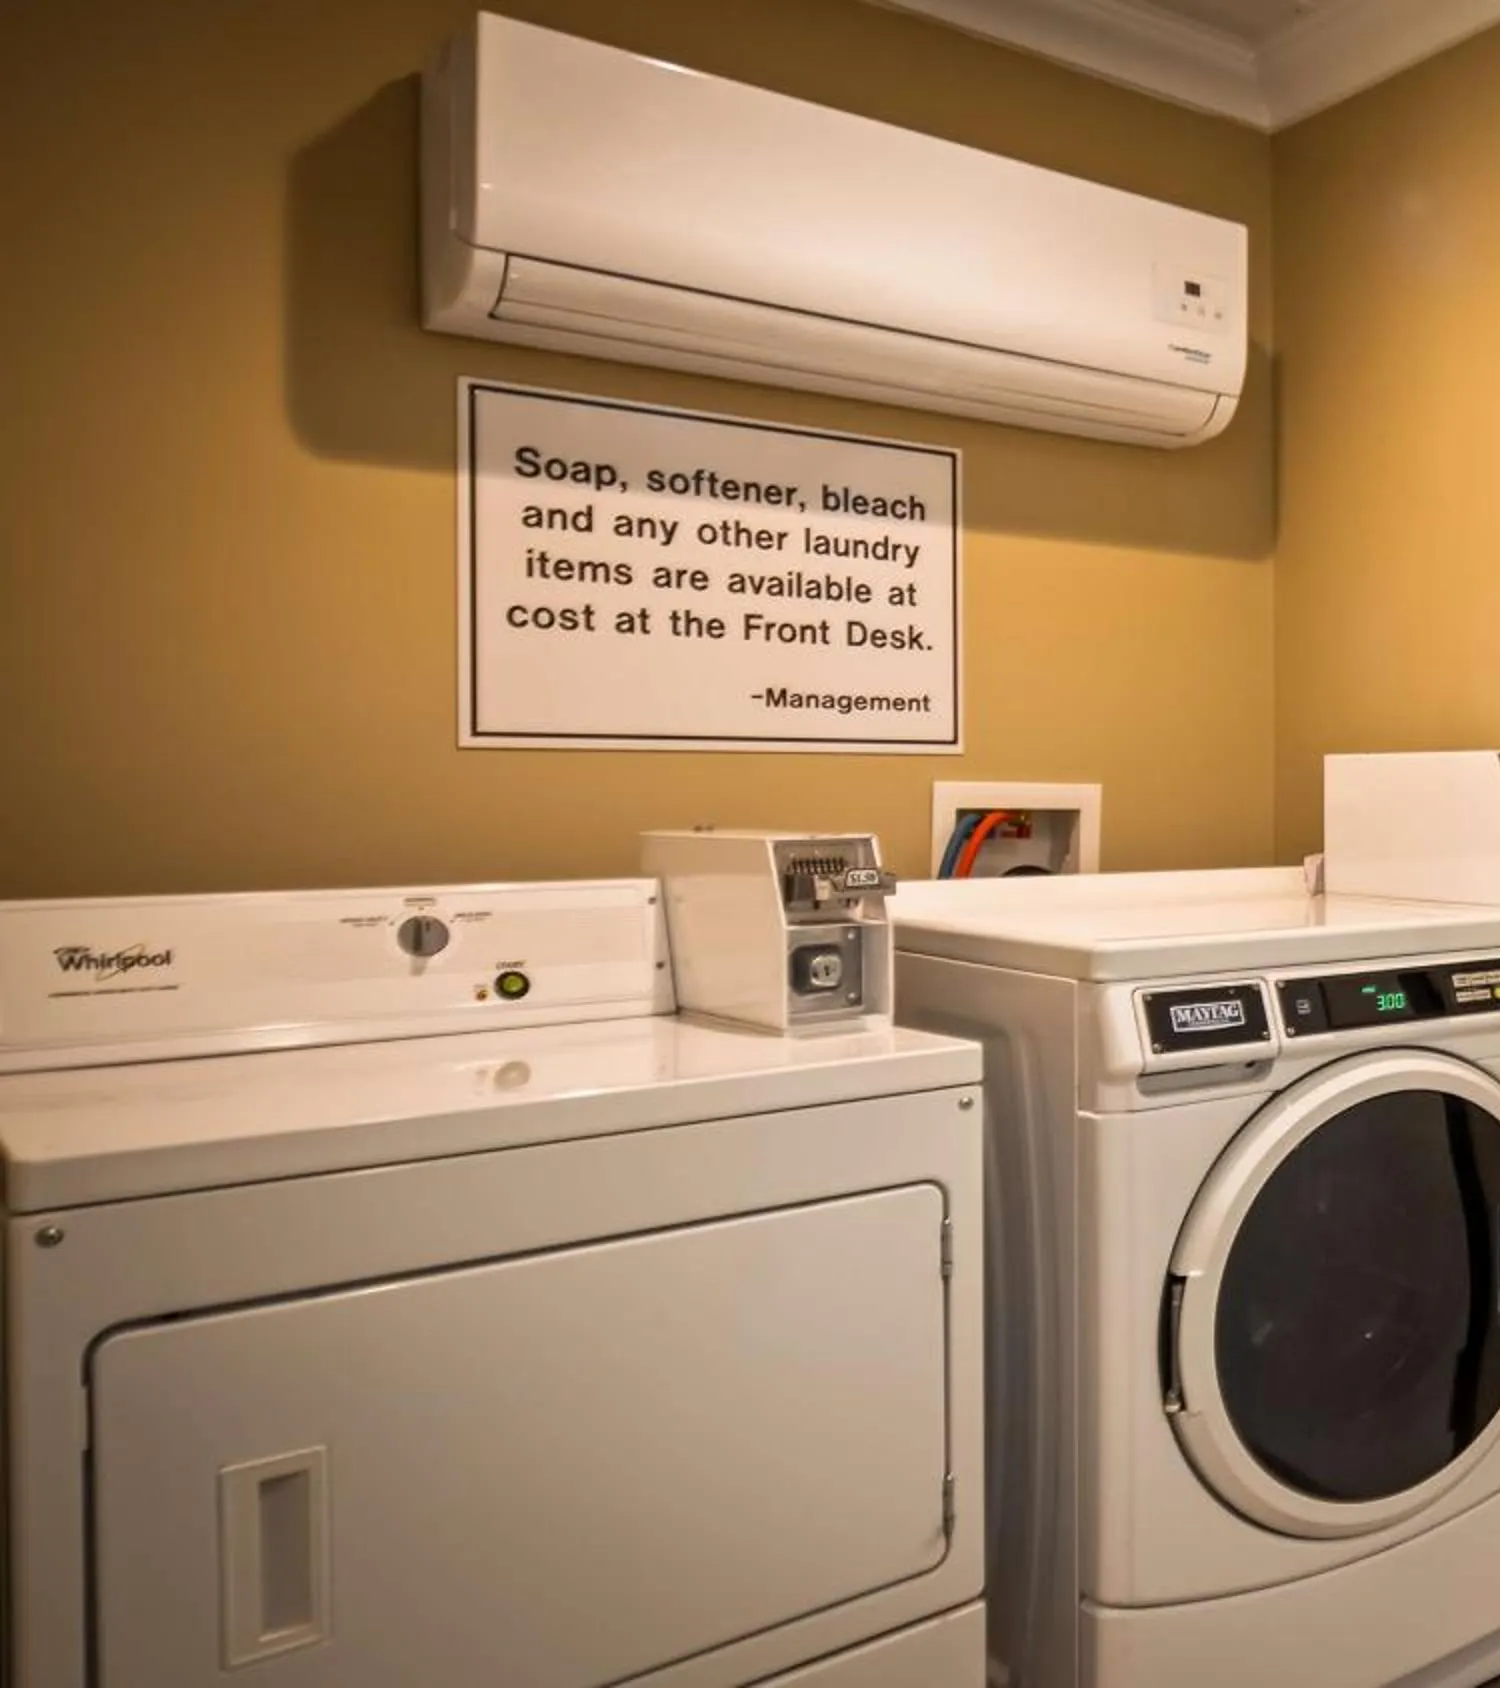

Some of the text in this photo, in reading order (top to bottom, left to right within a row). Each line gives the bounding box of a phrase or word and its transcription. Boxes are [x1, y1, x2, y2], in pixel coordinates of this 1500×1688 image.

[513, 445, 926, 522] Soap, softener, bleach
[520, 503, 921, 570] and any other laundry
[525, 547, 918, 608] items are available at
[505, 603, 934, 652] cost at the Front Desk.
[750, 687, 932, 716] -Management
[56, 949, 172, 974] Whirlpool
[1176, 1003, 1239, 1023] MAYTAG
